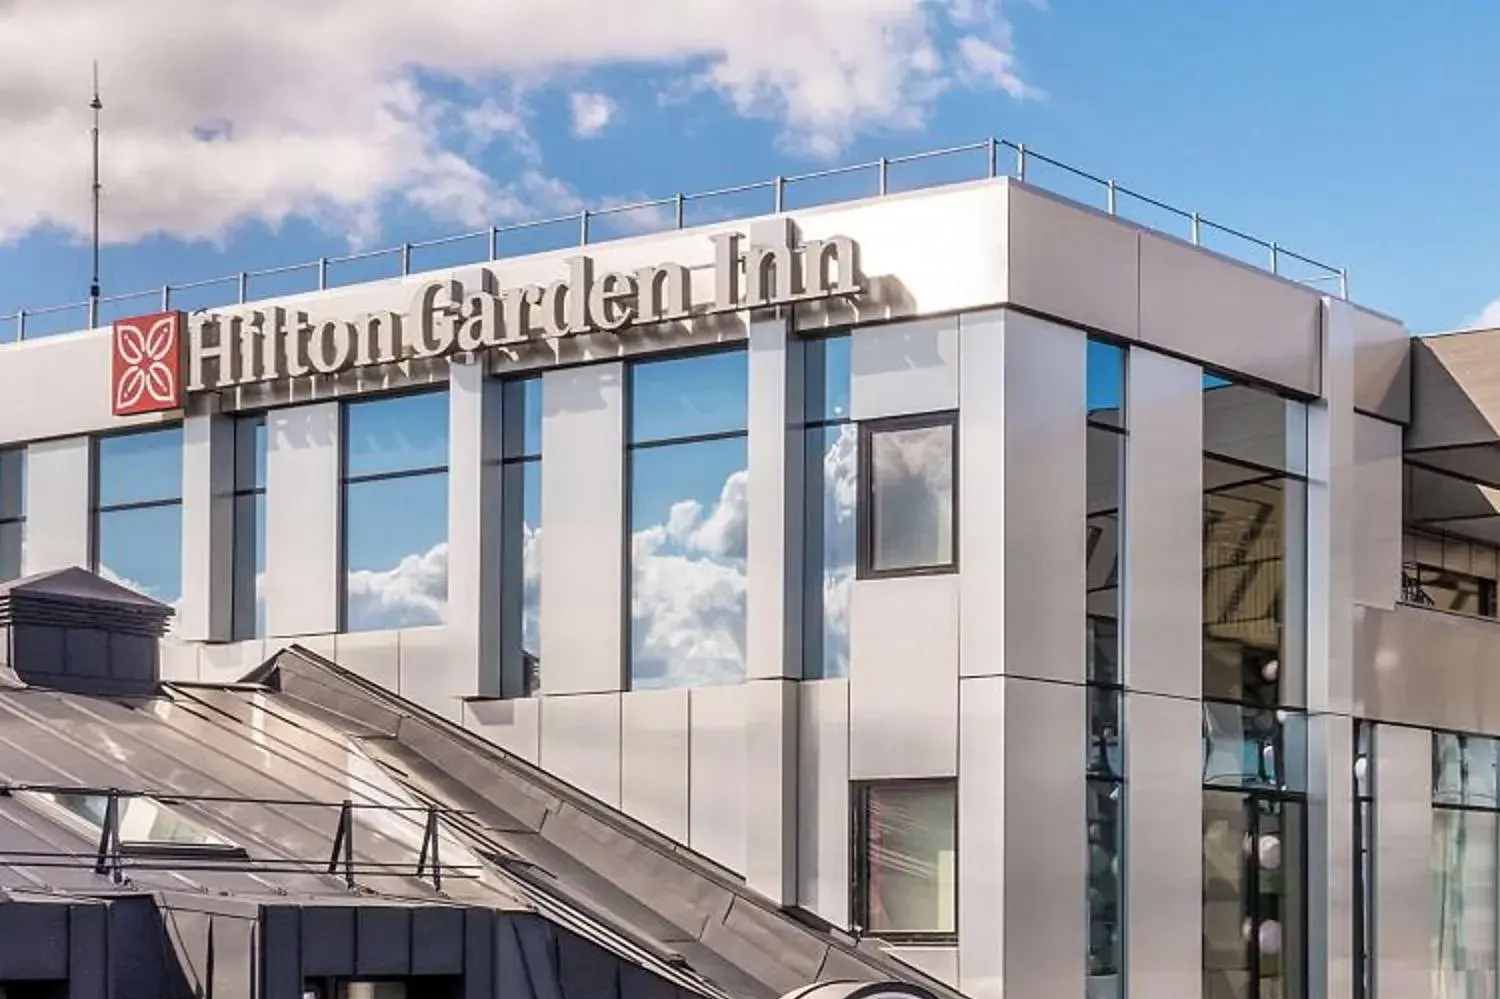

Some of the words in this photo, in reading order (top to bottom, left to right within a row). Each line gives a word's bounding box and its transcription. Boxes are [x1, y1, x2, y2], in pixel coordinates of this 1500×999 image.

[186, 305, 402, 391] Hilton
[408, 255, 691, 358] Garden
[709, 232, 864, 315] Inn
